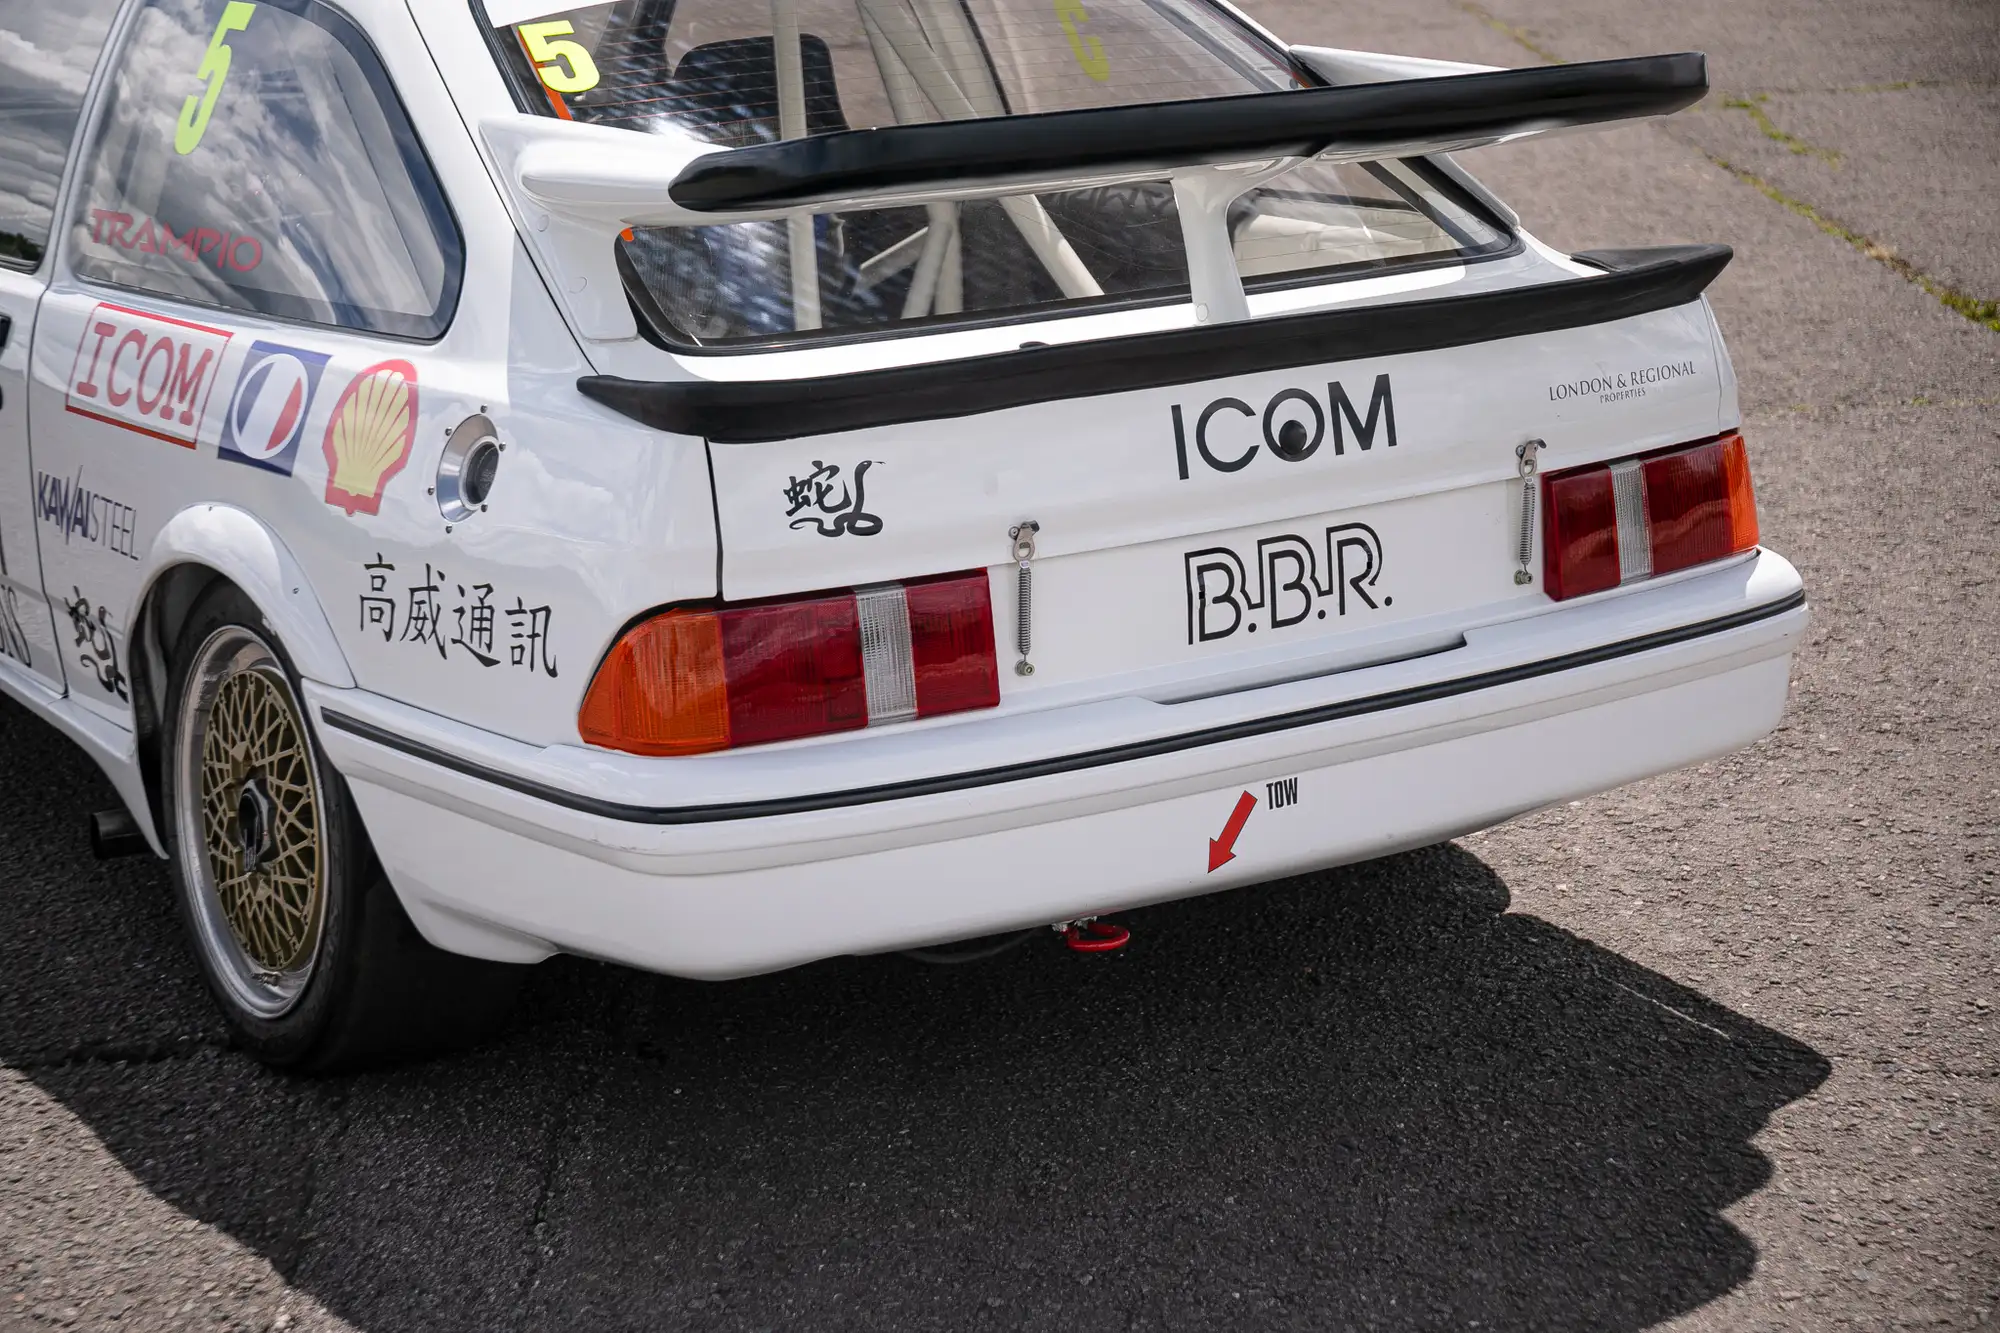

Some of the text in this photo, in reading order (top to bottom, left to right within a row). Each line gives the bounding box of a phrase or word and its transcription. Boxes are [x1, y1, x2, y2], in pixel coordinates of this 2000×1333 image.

[174, 1, 257, 156] 5
[518, 20, 600, 93] 5
[92, 208, 263, 272] TRAMPIO
[76, 321, 214, 426] ICOM
[1549, 361, 1696, 401] LONDON & REGIONAL
[1600, 387, 1646, 404] PROPERTIES
[1171, 373, 1398, 480] ICOM
[359, 552, 558, 678] 高威通訊
[1266, 777, 1298, 810] TOW
